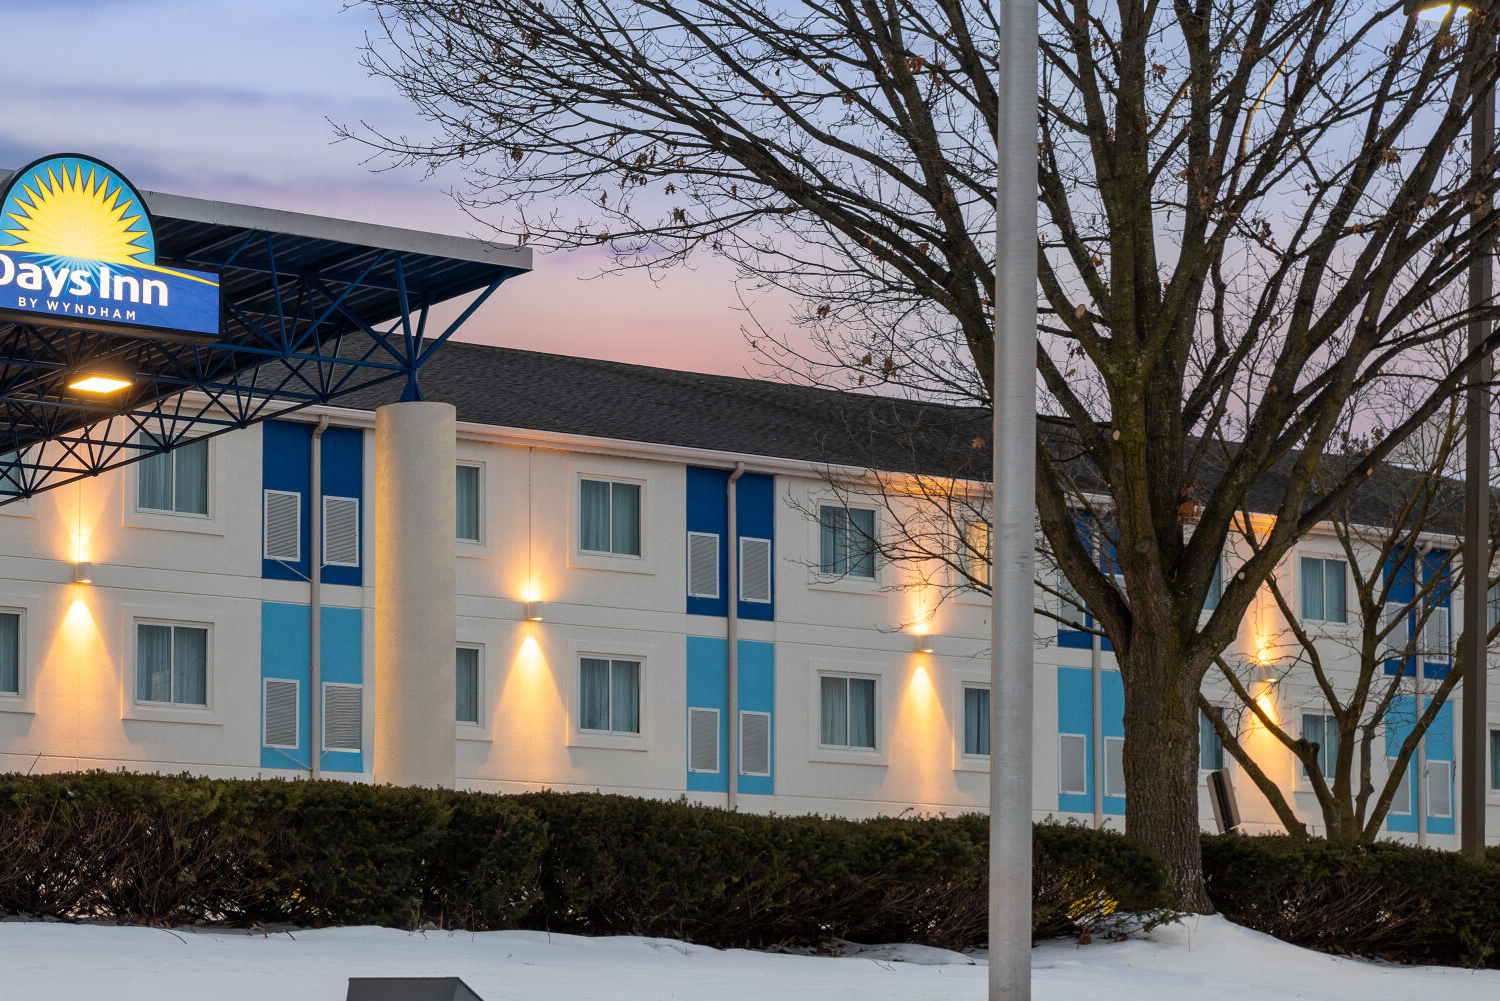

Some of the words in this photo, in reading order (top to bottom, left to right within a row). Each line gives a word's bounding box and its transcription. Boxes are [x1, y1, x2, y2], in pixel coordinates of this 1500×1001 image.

[100, 266, 168, 307] Inn
[18, 296, 38, 309] BY
[46, 300, 136, 321] WYNDHAM
